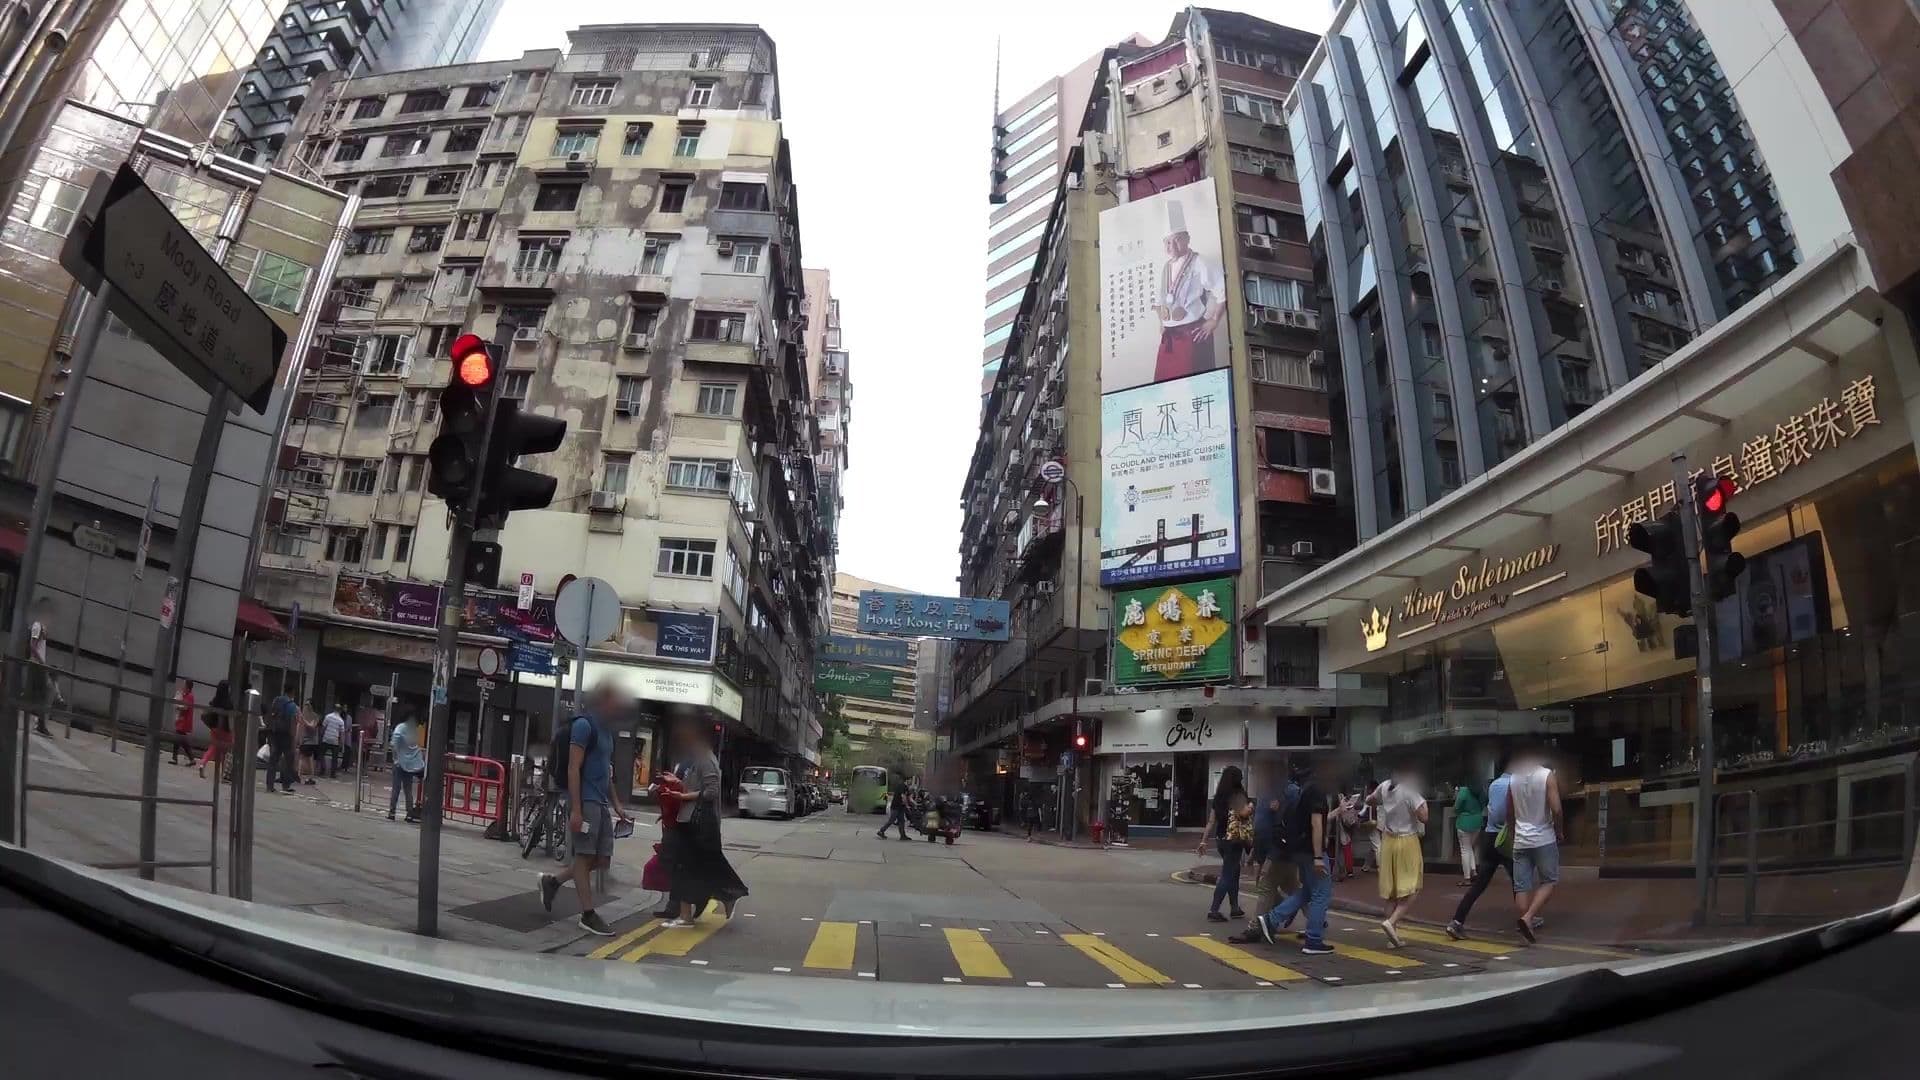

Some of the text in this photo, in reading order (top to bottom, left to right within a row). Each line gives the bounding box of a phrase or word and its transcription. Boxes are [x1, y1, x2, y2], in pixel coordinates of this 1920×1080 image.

[161, 231, 241, 323] Mody Road
[1110, 456, 1157, 470] CLOUDLAND
[1158, 448, 1192, 461] CHINESE
[1194, 443, 1226, 455] CUISINE
[1398, 543, 1561, 622] King Suleiman
[1121, 588, 1221, 628] 鹿鳴春
[865, 614, 971, 632] Hong Kong Fur
[674, 645, 689, 653] THIS
[1132, 644, 1206, 661] SPRING DEER
[818, 668, 870, 685] Amigo
[1141, 661, 1197, 673] RESTAURANT
[1166, 719, 1213, 748] Owl's
